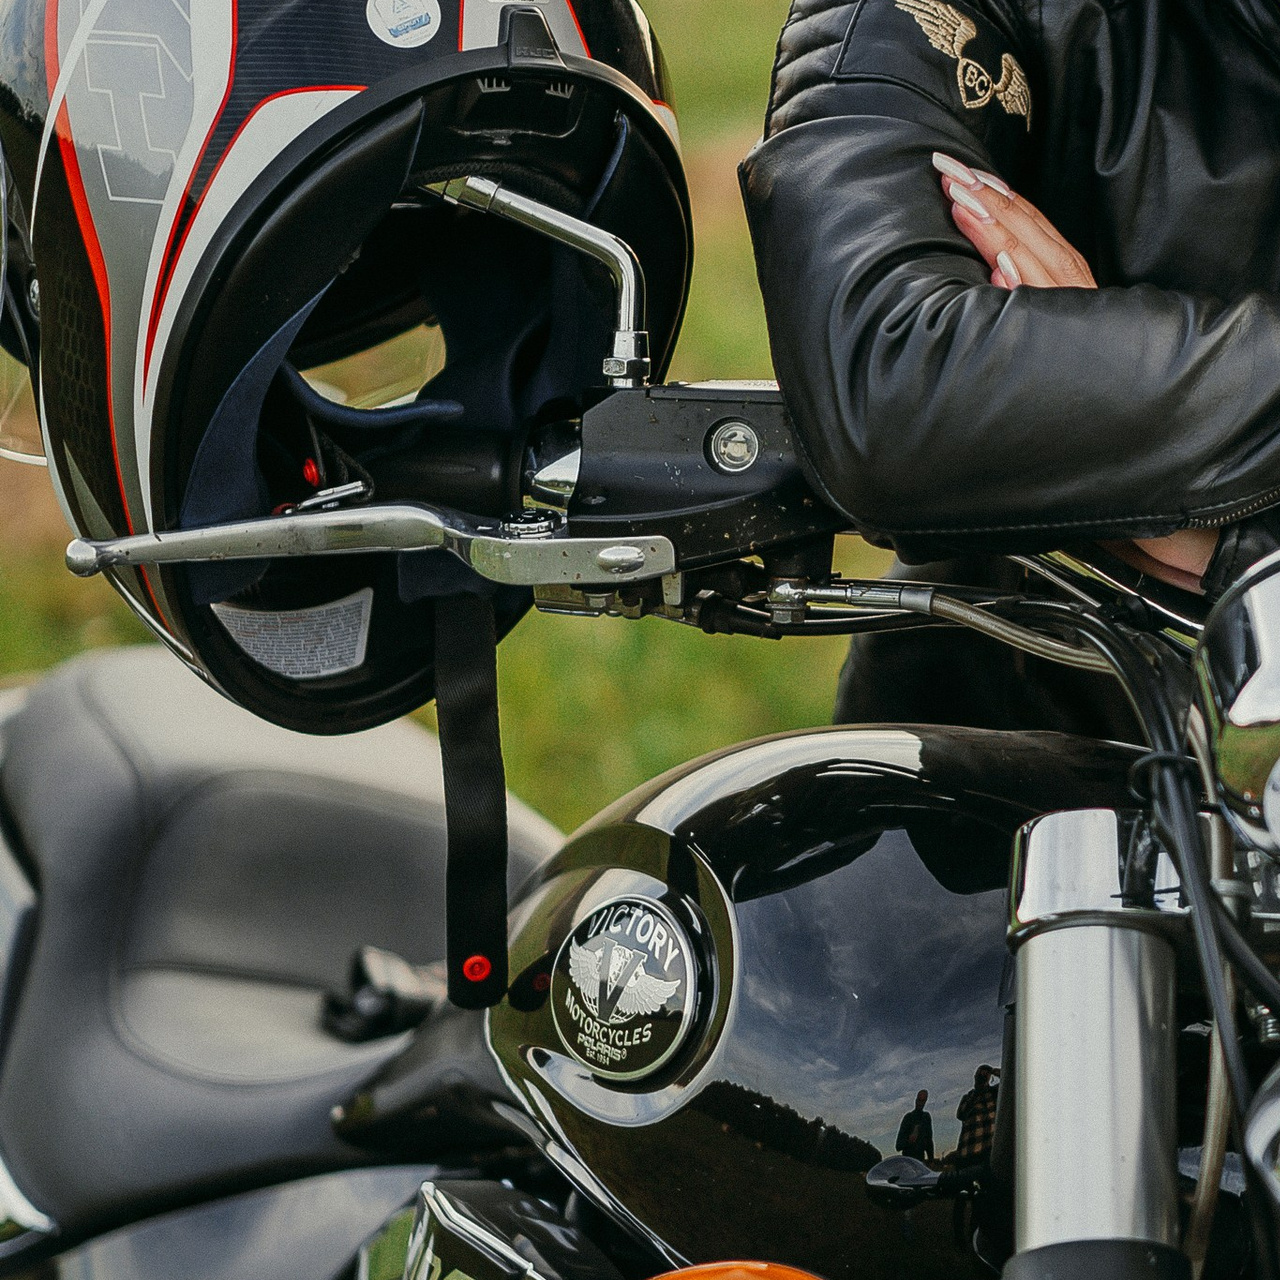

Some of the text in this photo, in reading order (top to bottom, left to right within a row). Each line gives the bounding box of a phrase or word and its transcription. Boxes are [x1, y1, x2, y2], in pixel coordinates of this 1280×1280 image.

[965, 65, 988, 97] BC
[588, 904, 680, 972] VICTORY
[565, 987, 652, 1046] MOTORCYCLES
